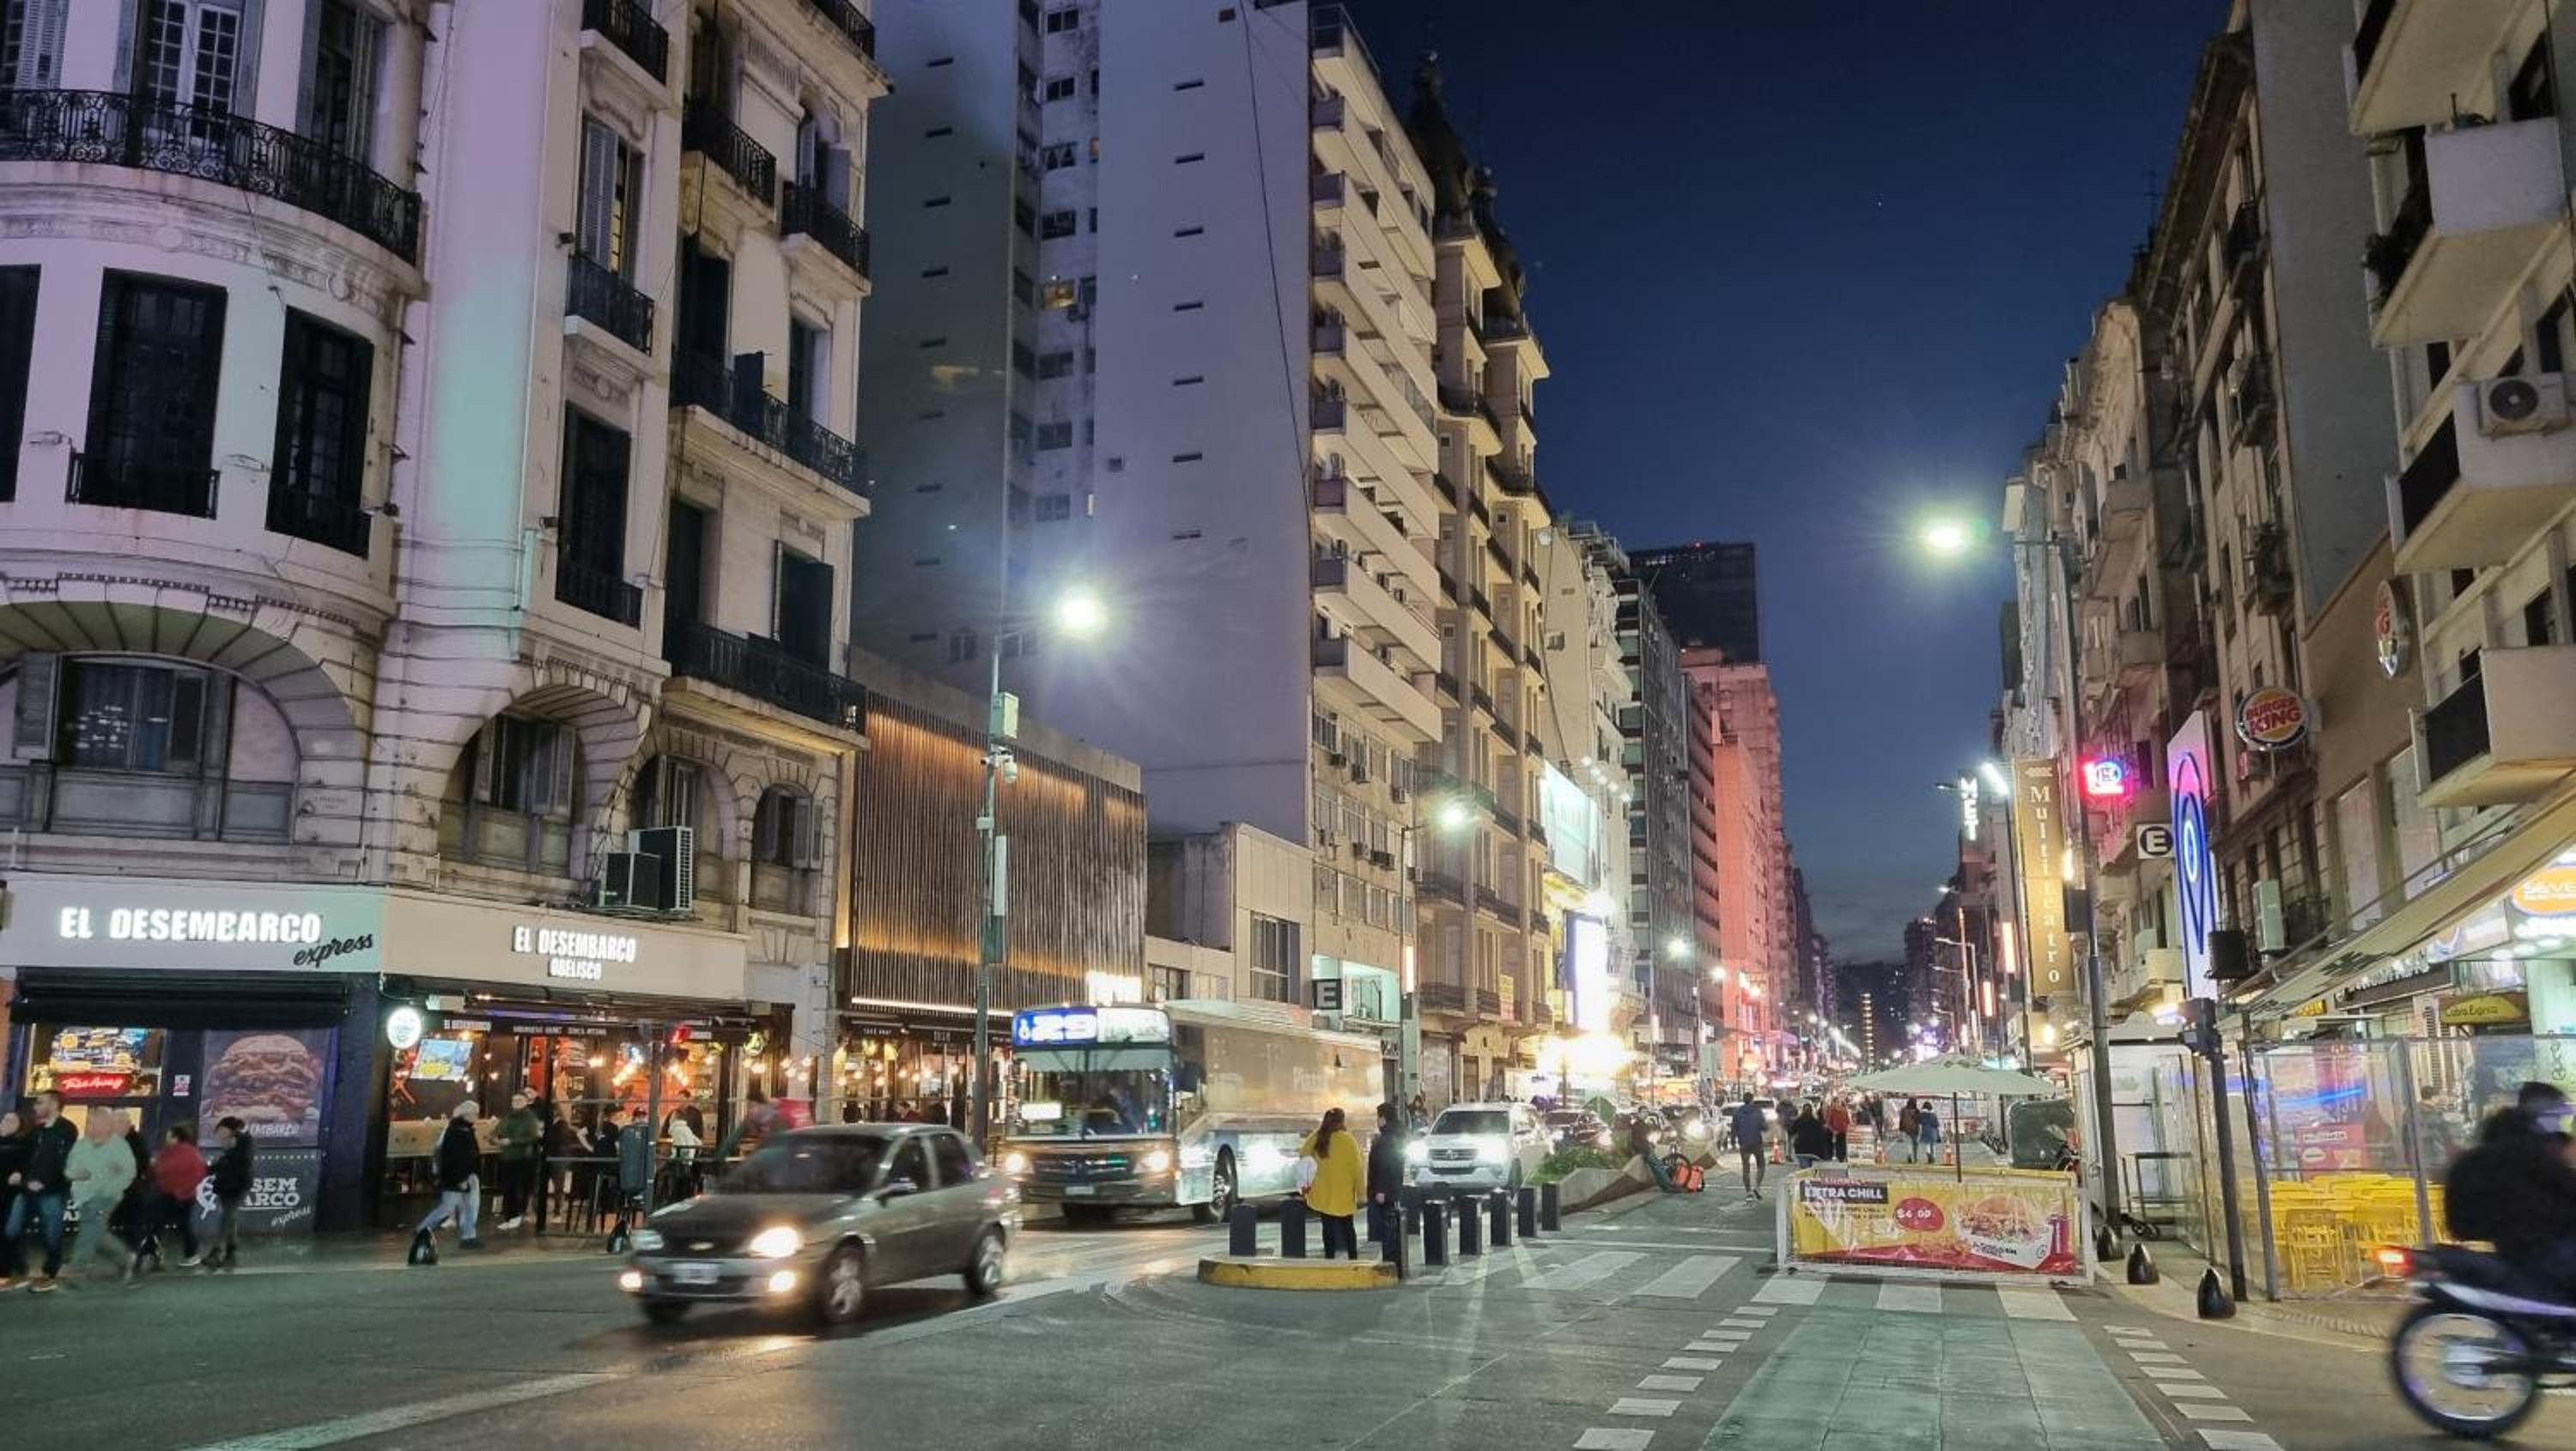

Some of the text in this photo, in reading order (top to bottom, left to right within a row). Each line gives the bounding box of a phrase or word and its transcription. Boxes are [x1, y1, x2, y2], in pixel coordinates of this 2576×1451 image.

[2246, 696, 2298, 719] BURGER
[2250, 707, 2302, 738] KING
[58, 907, 321, 944] EL DESEMBARCO
[293, 933, 373, 968] express
[513, 926, 637, 962] EL DESEMBARCO
[548, 956, 603, 980] OBELISCO
[1316, 981, 1337, 1008] E
[250, 1177, 299, 1193] SEM
[243, 1192, 301, 1207] ARCO
